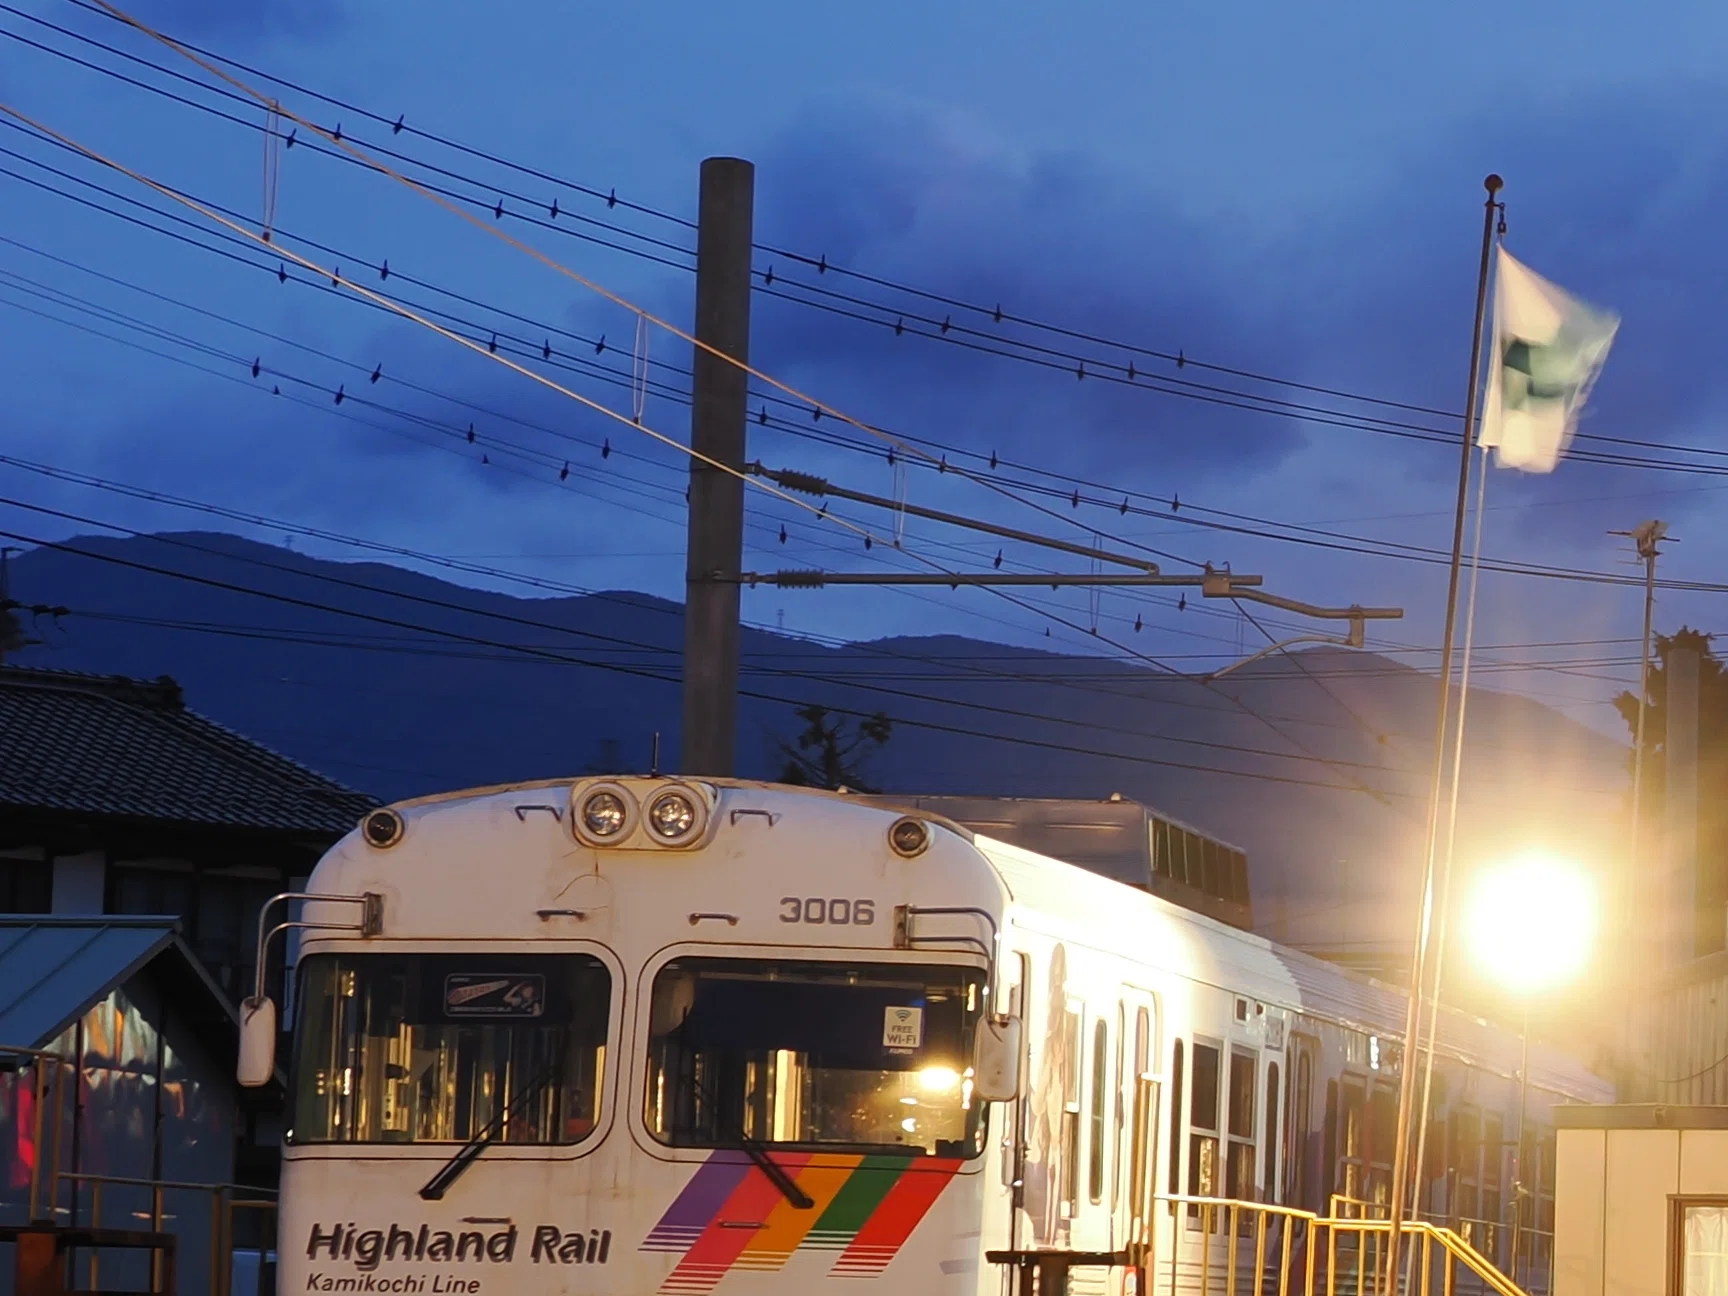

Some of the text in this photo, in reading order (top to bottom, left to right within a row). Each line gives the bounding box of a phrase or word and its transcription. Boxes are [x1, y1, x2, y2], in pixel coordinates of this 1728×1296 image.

[779, 897, 875, 925] 3006
[891, 1025, 913, 1033] FREE
[306, 1222, 612, 1271] Highland Rail
[306, 1273, 481, 1294] Kamikochi Line
